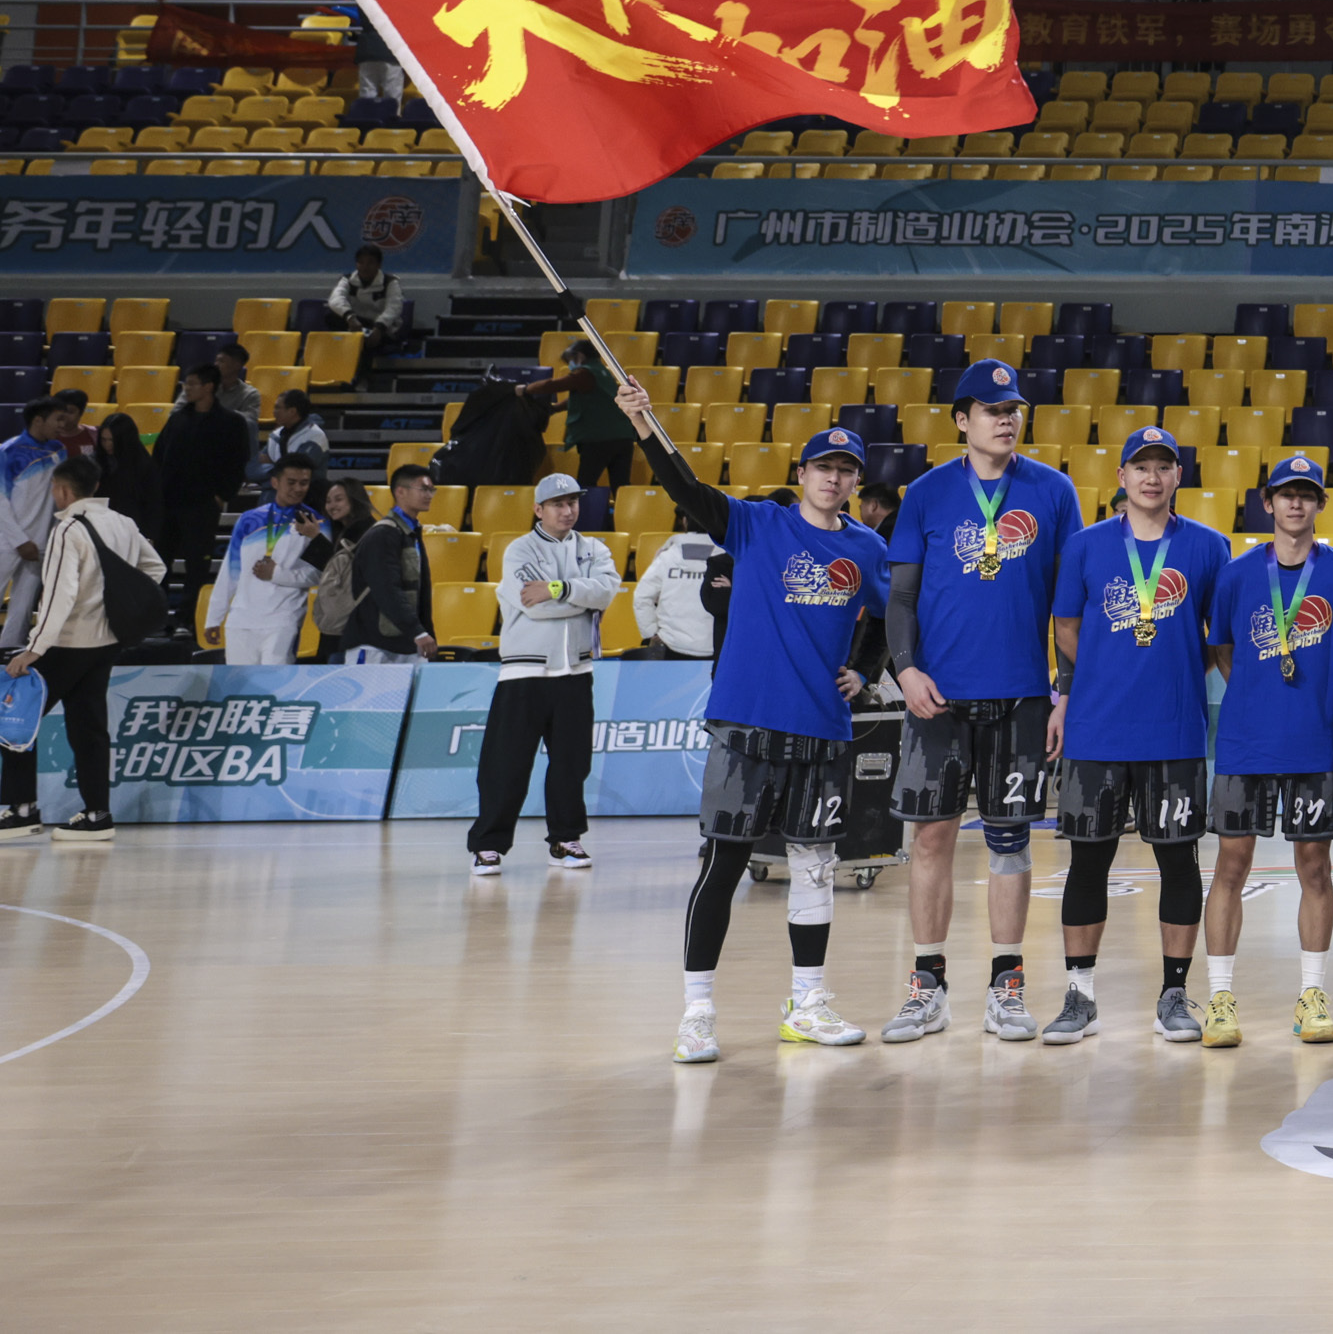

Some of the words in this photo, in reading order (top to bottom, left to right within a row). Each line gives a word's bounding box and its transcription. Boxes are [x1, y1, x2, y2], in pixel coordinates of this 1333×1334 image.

[784, 594, 849, 607] CHAMPION
[124, 698, 316, 741] 我的联赛
[1002, 770, 1045, 805] 21
[810, 795, 842, 829] 12
[1160, 797, 1193, 829] 14
